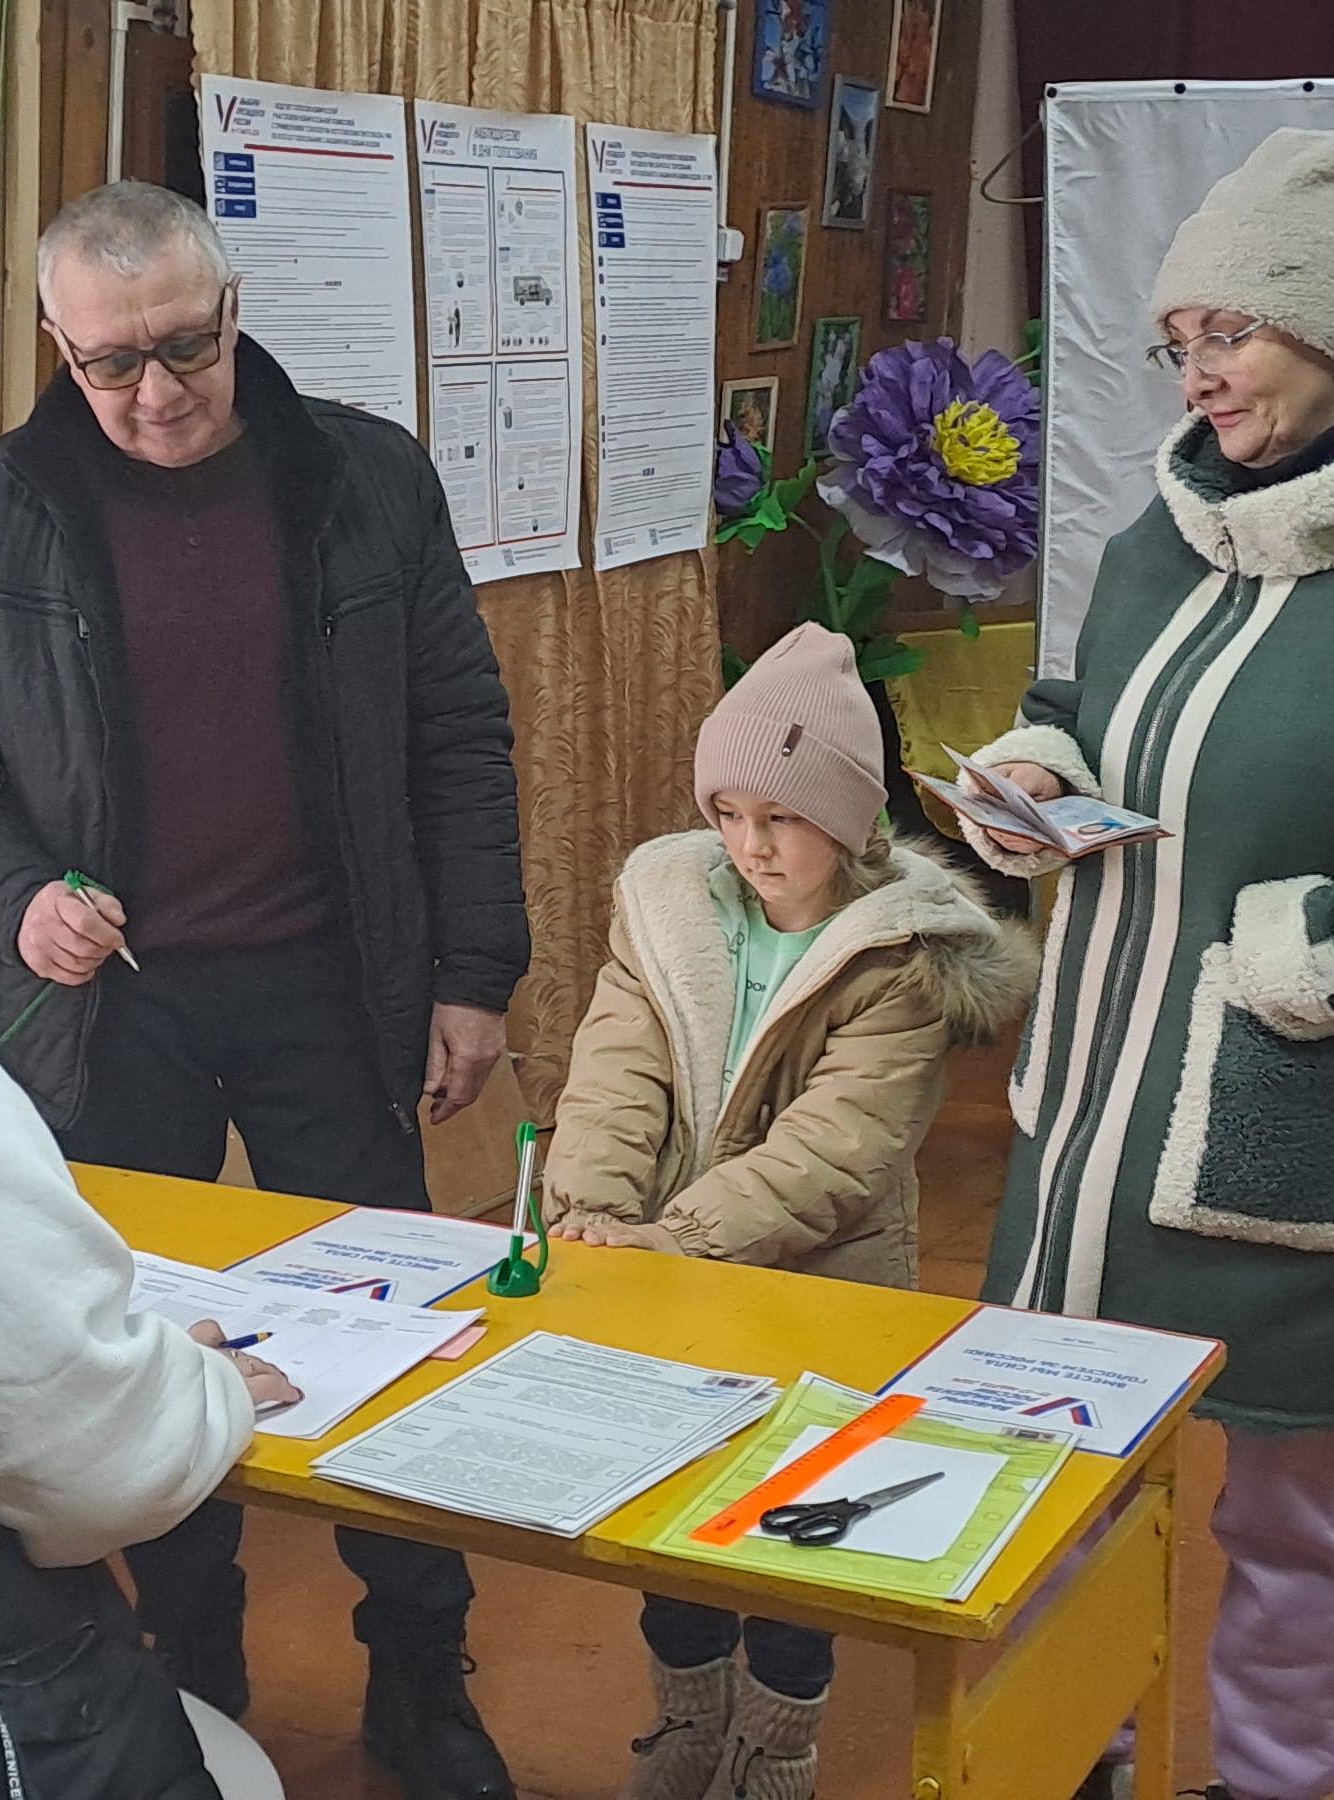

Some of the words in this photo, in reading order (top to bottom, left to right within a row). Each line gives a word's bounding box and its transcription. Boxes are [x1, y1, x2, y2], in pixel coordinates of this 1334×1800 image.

[962, 1348, 1037, 1365] РОССИЮ!
[985, 1358, 1028, 1371] СИЛА
[1040, 1360, 1061, 1369] ЗА
[1031, 1366, 1061, 1377] МЫ
[1061, 1364, 1149, 1385] ГОЛОСУЕМ
[1065, 1372, 1128, 1390] ВМЕСТЕ
[936, 1395, 1013, 1413] ВЫБОРЫ
